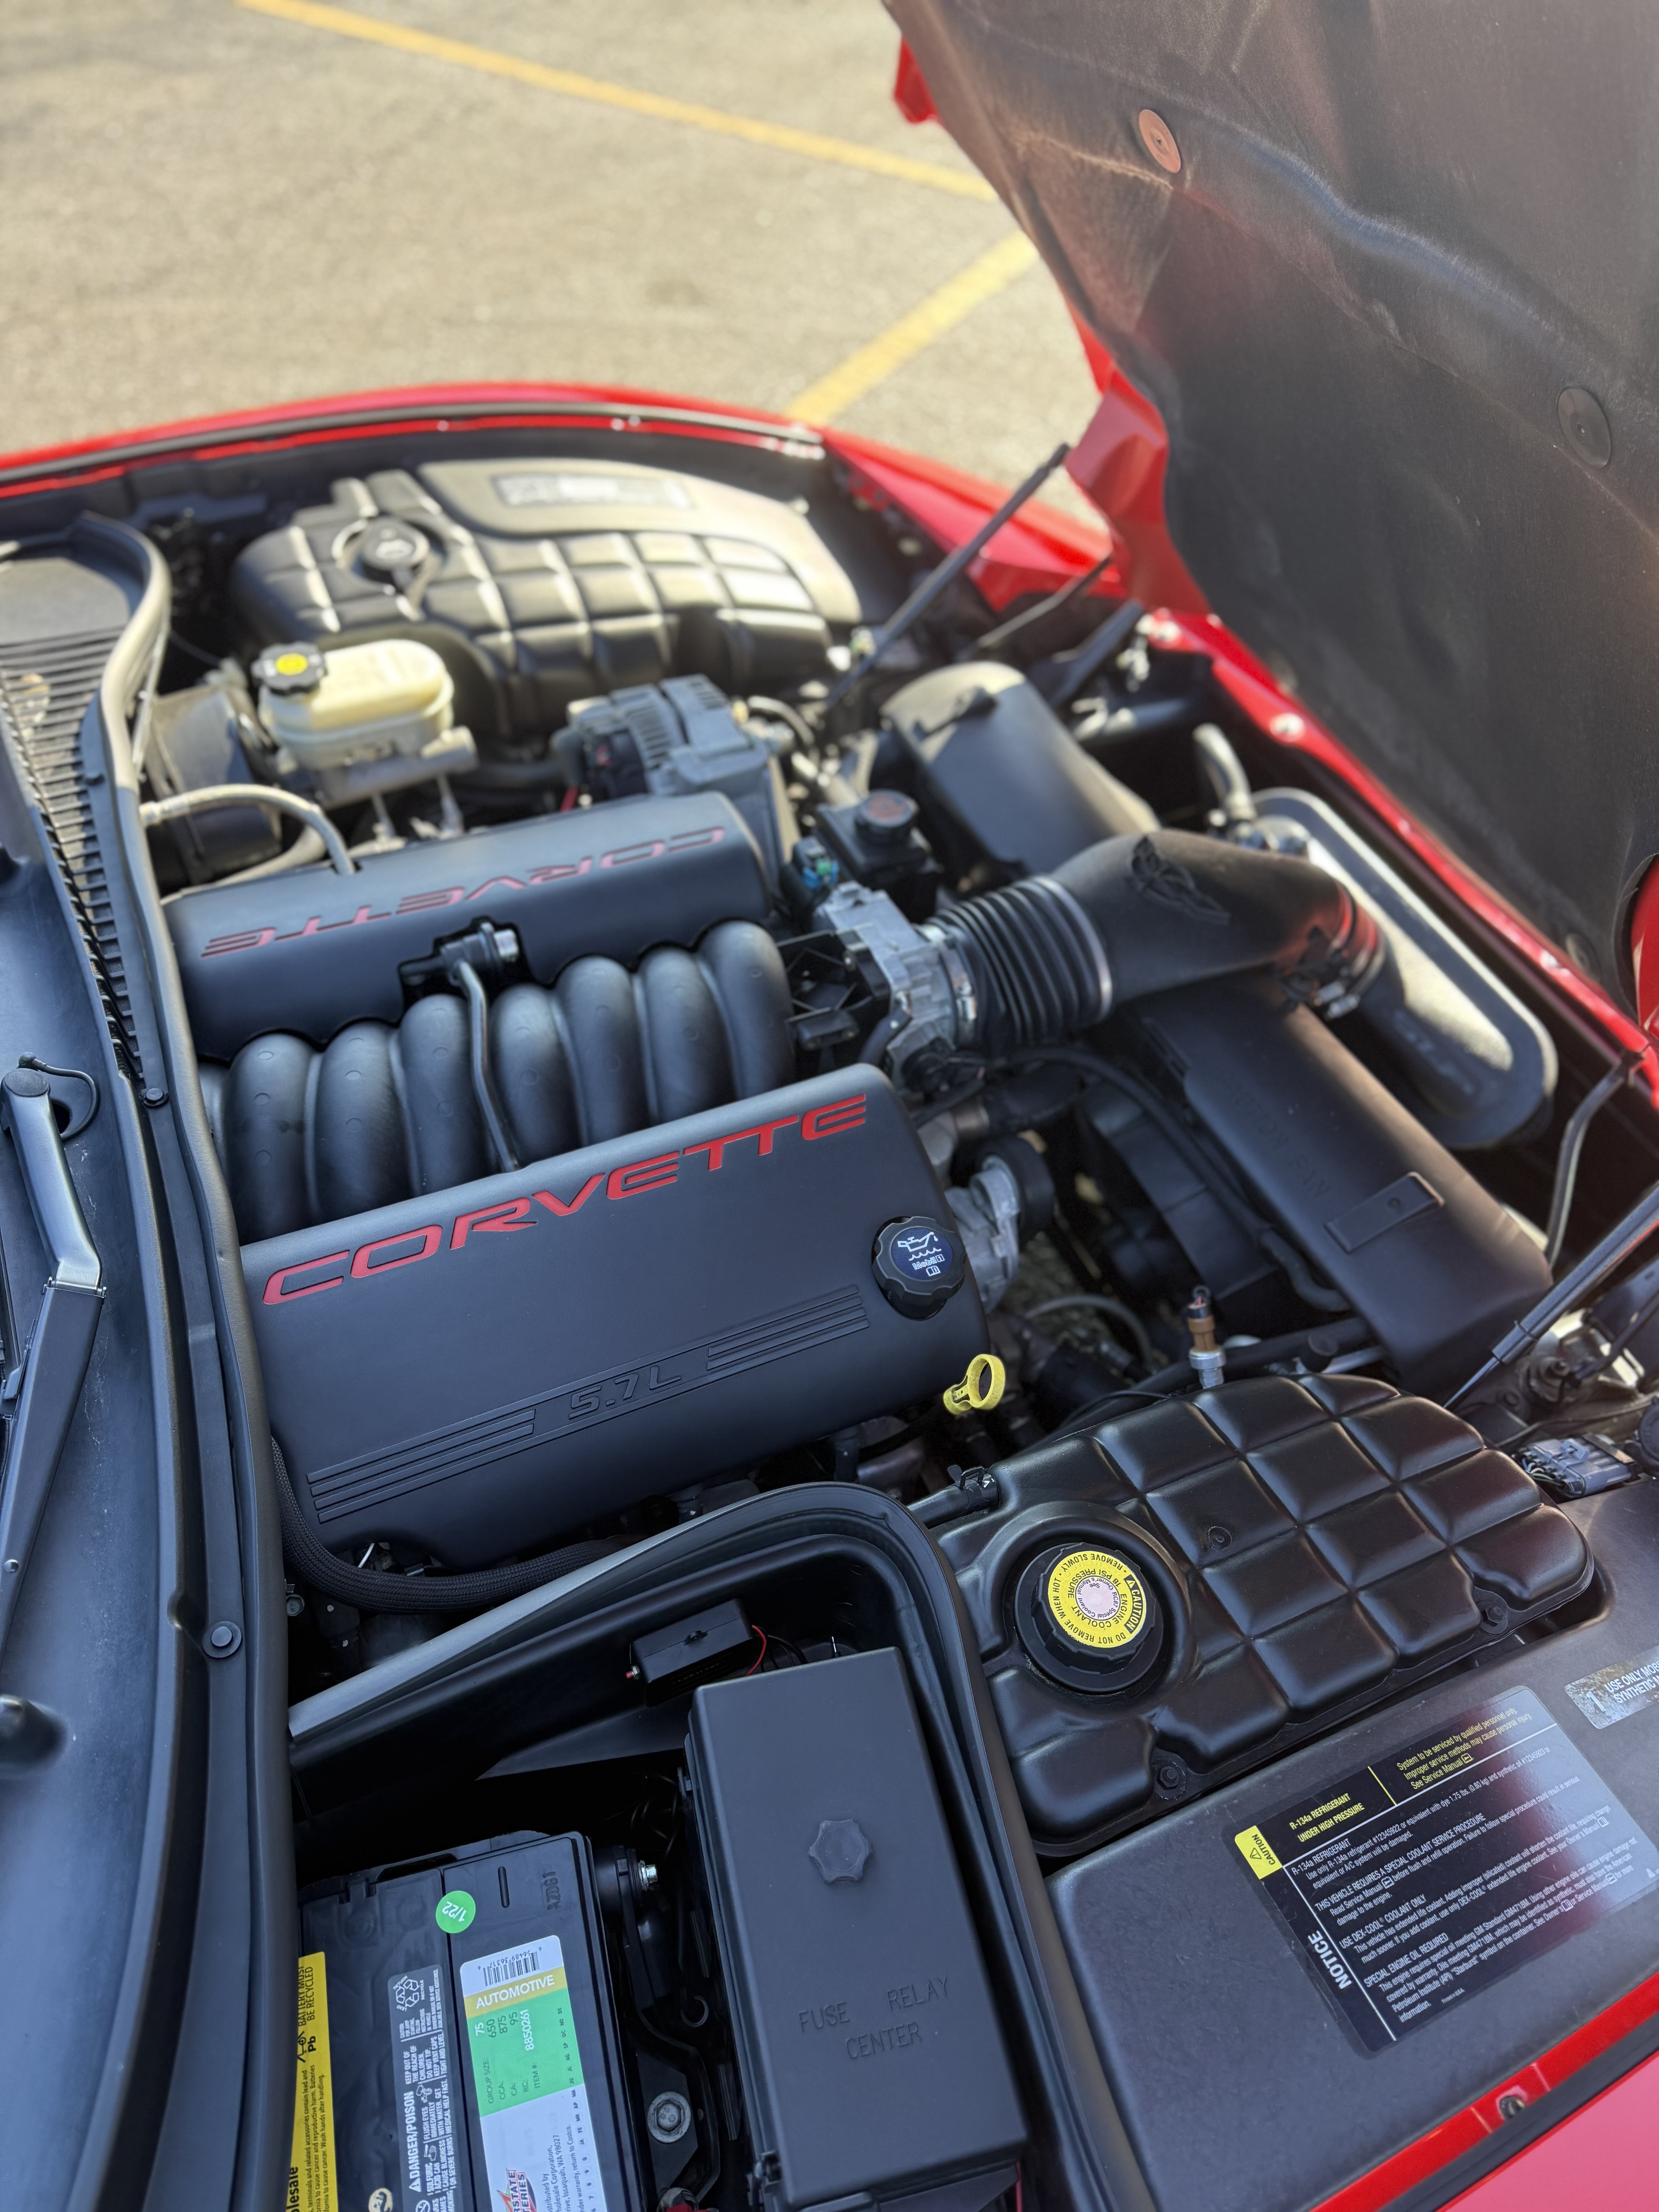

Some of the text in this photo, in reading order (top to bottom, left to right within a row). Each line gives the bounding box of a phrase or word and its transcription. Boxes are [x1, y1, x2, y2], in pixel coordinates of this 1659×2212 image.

[201, 826, 726, 959] CORVETTE
[263, 1095, 865, 1303] CORVETTE
[912, 1257, 937, 1270] Mobil
[568, 1364, 682, 1420] 5.7L
[1061, 1554, 1123, 1572] REMOVE SLOWLY
[1068, 1569, 1121, 1598] 18 PSI PRESSURE
[1077, 1578, 1113, 1595] Owner's Manual
[1053, 1596, 1066, 1619] WHEN
[1072, 1594, 1127, 1628] ENGINE COOLANT
[1078, 1598, 1095, 1617] Coolant
[1097, 1607, 1116, 1618] Special
[1127, 1590, 1142, 1630] CAUTION
[1065, 1620, 1094, 1642] REMOVE
[1116, 1632, 1126, 1641] DO
[1586, 1690, 1606, 1712] 1
[1613, 1679, 1656, 1703] SYNTHETIC
[1604, 1679, 1625, 1693] USE
[1621, 1670, 1643, 1685] ONLY
[1396, 1756, 1419, 1770] System
[1431, 1736, 1455, 1753] serviced
[1460, 1723, 1483, 1739] qualified
[1481, 1712, 1506, 1729] personnel
[1504, 1707, 1517, 1717] only.
[1403, 1713, 1532, 1780] Improper service methods may cause personal injury.
[1410, 1758, 1463, 1789] See Service Manual
[1289, 1793, 1350, 1830] R-134a REFRIGERANT
[1297, 1802, 1364, 1842] UNDER HIGH PRESSURE
[1252, 1833, 1276, 1865] CAUTION
[1291, 1838, 1351, 1875] R-134a REFRIGERANT
[1314, 1813, 1486, 1911] THIS VEHICLE REQUIRES A SPECIAL COOLANT SERVICE PROCEDURE
[441, 1900, 467, 1923] 1/22
[1339, 1893, 1426, 1949] USE DEX-COOL® COOLANT ONLY
[489, 1950, 531, 1968] 56489 36317
[1307, 1930, 1351, 1989] NOTICE
[1364, 1932, 1449, 1987] SPECIAL ENGINE OIL REQUIRED
[304, 1966, 315, 2022] BE RECYCLED
[476, 1974, 555, 2009] AUTOMOTIVE
[798, 1975, 948, 2033] FUSE RELAY
[475, 2022, 484, 2036] 75
[486, 2019, 496, 2037] 650
[497, 2015, 507, 2033] 875
[508, 2012, 518, 2025] 95
[520, 2009, 534, 2051] 8850261
[307, 2036, 316, 2052] Pb
[846, 2021, 922, 2060] CENTER
[426, 2069, 433, 2078] DO
[438, 2059, 447, 2075] TIGHT
[485, 2076, 494, 2104] GROUP
[428, 2102, 437, 2138] IMMEDIATELY
[443, 2108, 452, 2133] MEDICAL
[403, 2091, 420, 2179] DANGER/POISON
[553, 2135, 562, 2155] 98027
[438, 2139, 449, 2188] CAUSE BLINDNESS
[447, 2155, 455, 2178] SEVERE
[556, 2155, 563, 2167] WA
[424, 2162, 434, 2192] SULFURIC
[432, 2162, 441, 2190] ACID CAN
[448, 2176, 456, 2185] OR
[541, 2174, 549, 2182] by
[547, 2145, 562, 2212] holesale Corporation,
[558, 2167, 568, 2197] Issaquah,
[574, 2171, 582, 2198] warranty,
